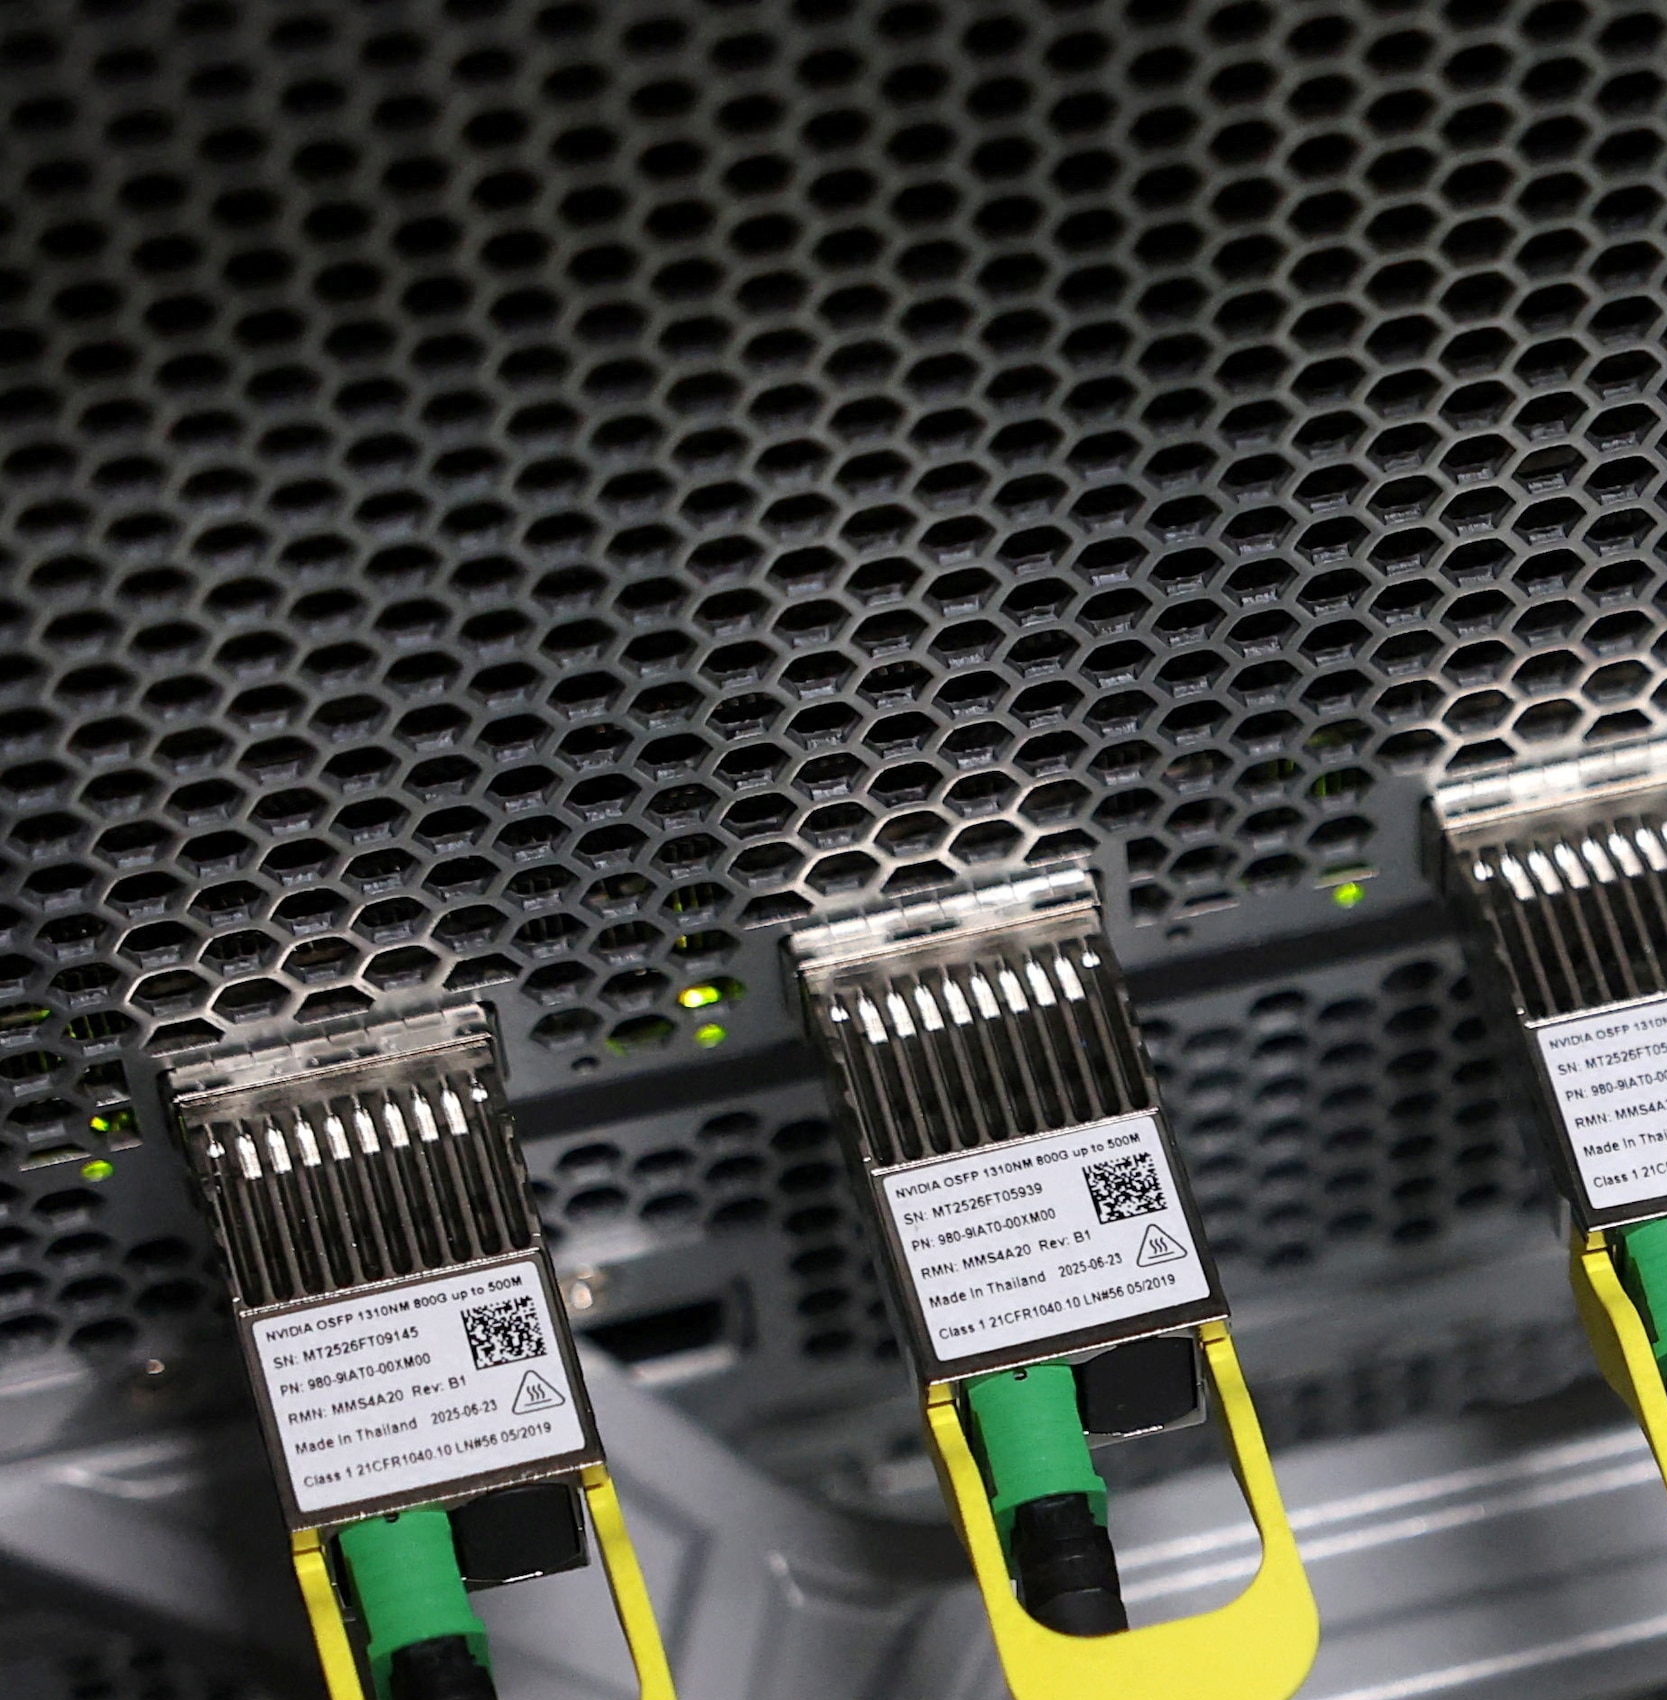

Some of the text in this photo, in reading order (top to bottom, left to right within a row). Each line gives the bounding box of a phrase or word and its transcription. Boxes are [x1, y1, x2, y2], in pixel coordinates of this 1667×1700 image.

[1548, 1032, 1594, 1050] NVIDIA
[1595, 1024, 1630, 1040] OSFP
[1556, 1061, 1579, 1076] SN:
[1564, 1087, 1589, 1103] PN:
[1573, 1112, 1612, 1130] RMN:
[895, 1132, 1141, 1199] NVIDIA OSFP 1310NM 800G up to 500M
[1583, 1141, 1620, 1157] Made
[1621, 1137, 1637, 1149] In
[1593, 1173, 1629, 1188] Class
[1631, 1168, 1639, 1180] 1
[903, 1182, 1043, 1226] SN: MT2526FT05939
[910, 1237, 936, 1253] PN:
[920, 1229, 1091, 1280] RMN: MMS4A20 Rev: B1
[928, 1252, 1123, 1308] Made In Thailand 2025-06-23
[265, 1275, 523, 1342] NVIDIA OSFP 1310NM 800G up to 500M
[938, 1273, 1176, 1340] Class 1 21CFR1040.10 LN#56 05/2019
[272, 1325, 419, 1370] SN: MT2526FT09145
[279, 1381, 304, 1398] PN:
[287, 1374, 467, 1426] RMN: MMS4A20 Rev: B1
[294, 1398, 498, 1455] Made In Thailand 2025-06-23
[303, 1421, 552, 1488] Class 1 21CFR1040.10 LN#56 05/2019
